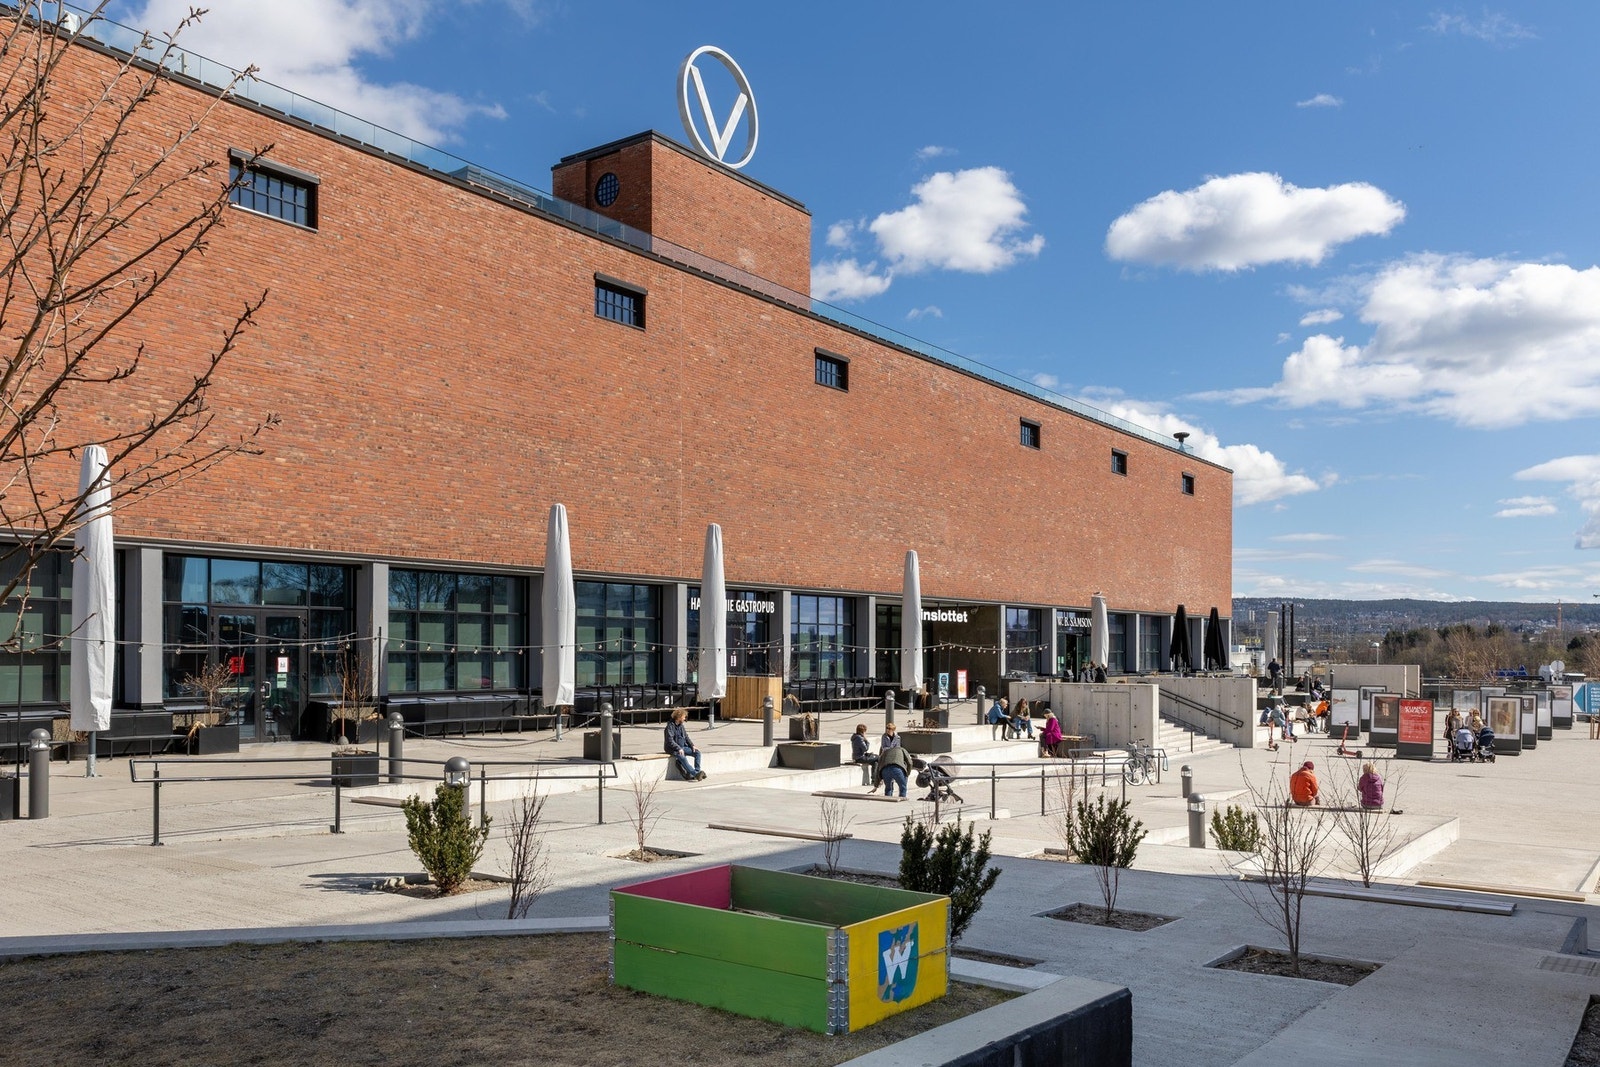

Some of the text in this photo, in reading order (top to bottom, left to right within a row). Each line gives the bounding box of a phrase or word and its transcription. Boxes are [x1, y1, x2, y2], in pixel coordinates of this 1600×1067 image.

[690, 64, 748, 161] V
[735, 599, 775, 614] GASTROPUB
[920, 608, 968, 623] inslottet
[1070, 617, 1092, 628] SAMSON
